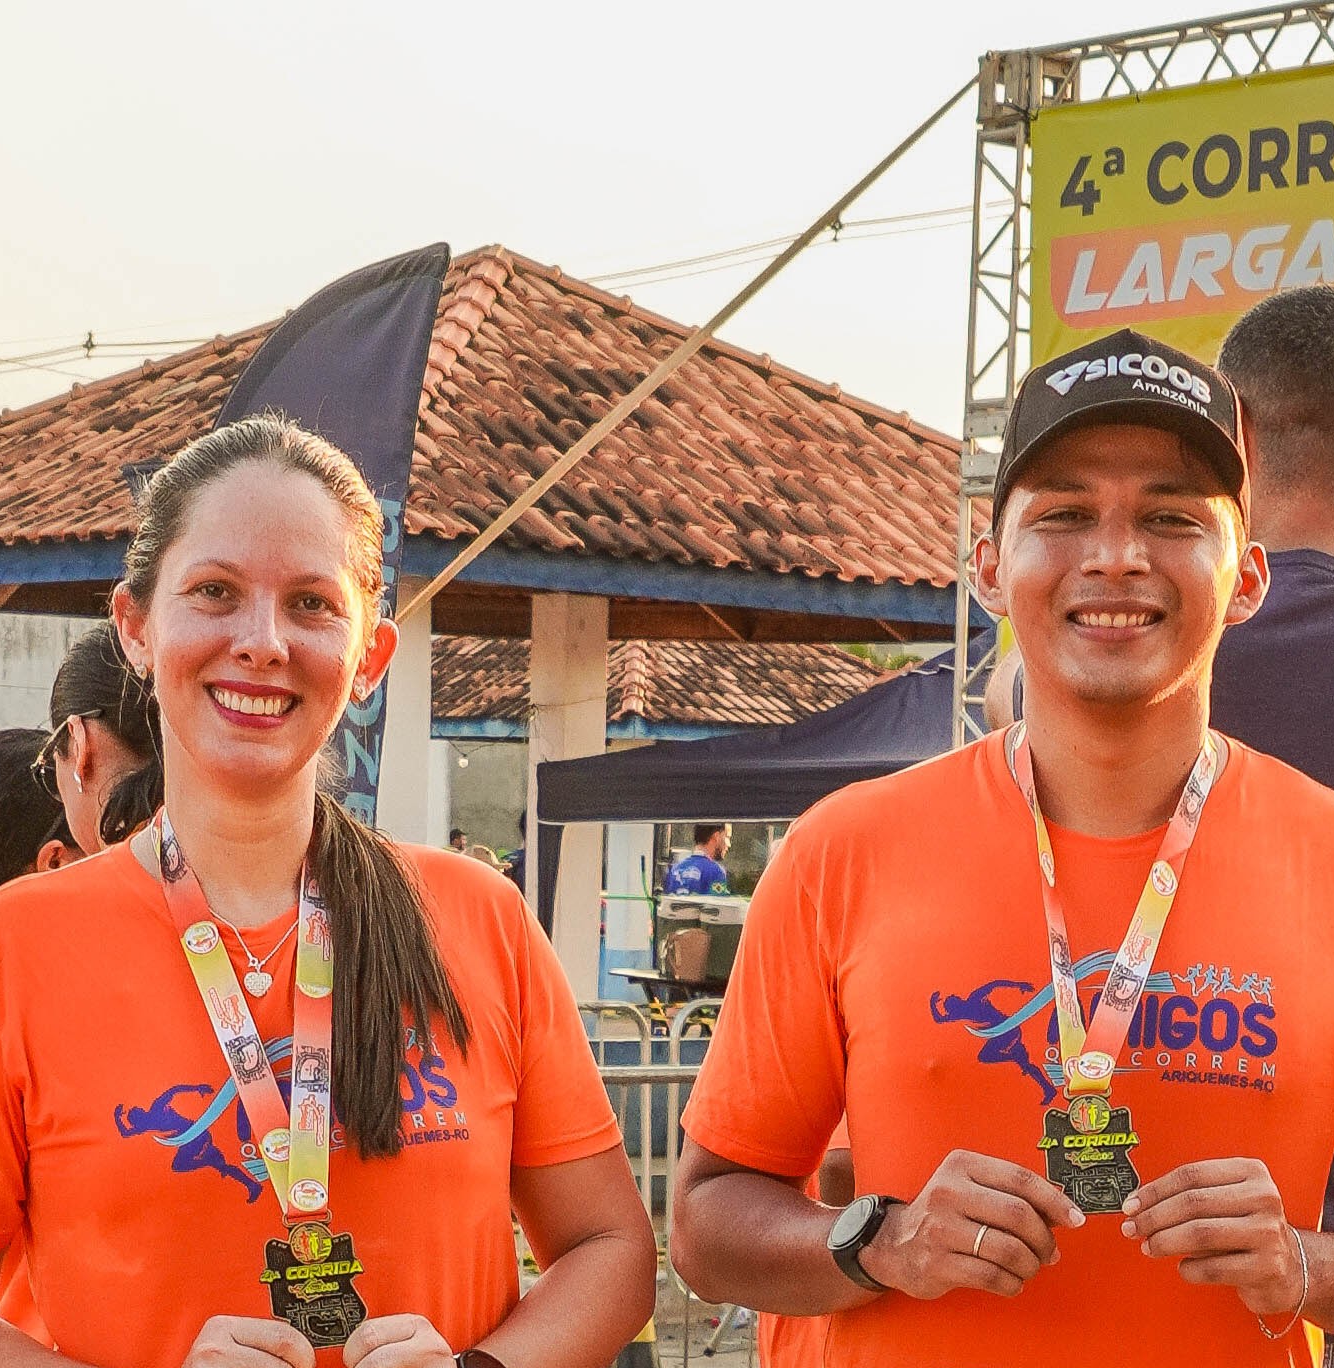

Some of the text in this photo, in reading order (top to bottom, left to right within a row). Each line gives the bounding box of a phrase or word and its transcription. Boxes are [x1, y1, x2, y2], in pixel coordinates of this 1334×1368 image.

[1060, 146, 1125, 217] 4ª
[1085, 353, 1212, 404] SICOOB
[1131, 1050, 1277, 1078] CORREM
[1161, 1069, 1275, 1094] ARIQUEMES-RO
[1063, 1131, 1140, 1149] CORRIDA
[286, 1259, 364, 1281] CORRIDA
